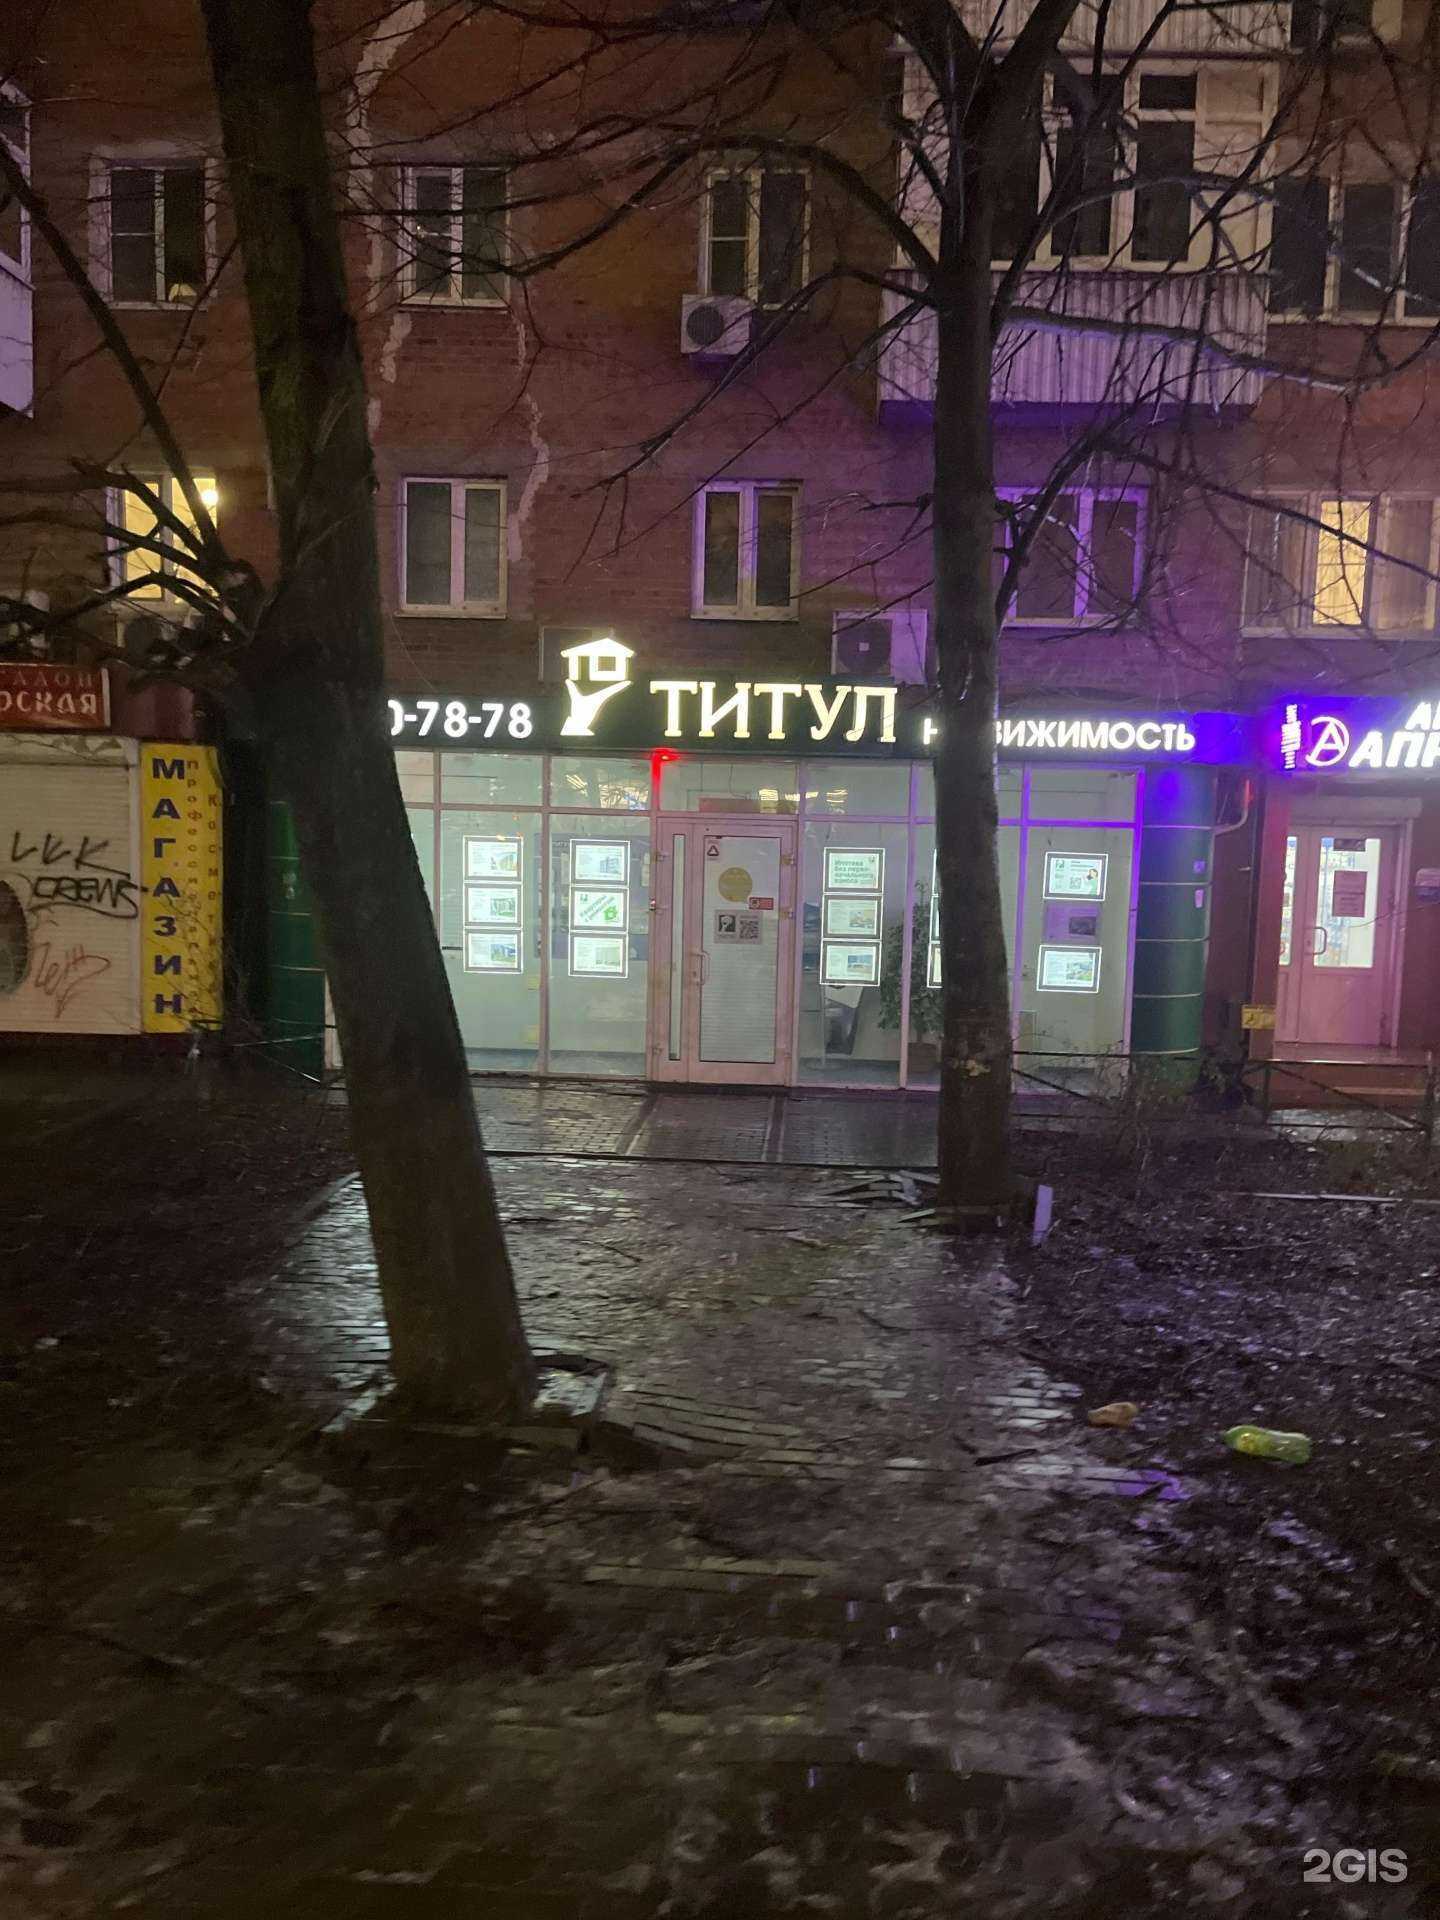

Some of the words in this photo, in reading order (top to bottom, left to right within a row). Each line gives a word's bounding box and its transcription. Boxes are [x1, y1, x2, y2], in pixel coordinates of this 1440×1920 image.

[0, 670, 93, 688] АЛОН
[649, 680, 898, 743] ТИТУЛ
[924, 716, 1196, 752] НИЖИМОСТЬ
[151, 757, 187, 1015] МАГАЗИН
